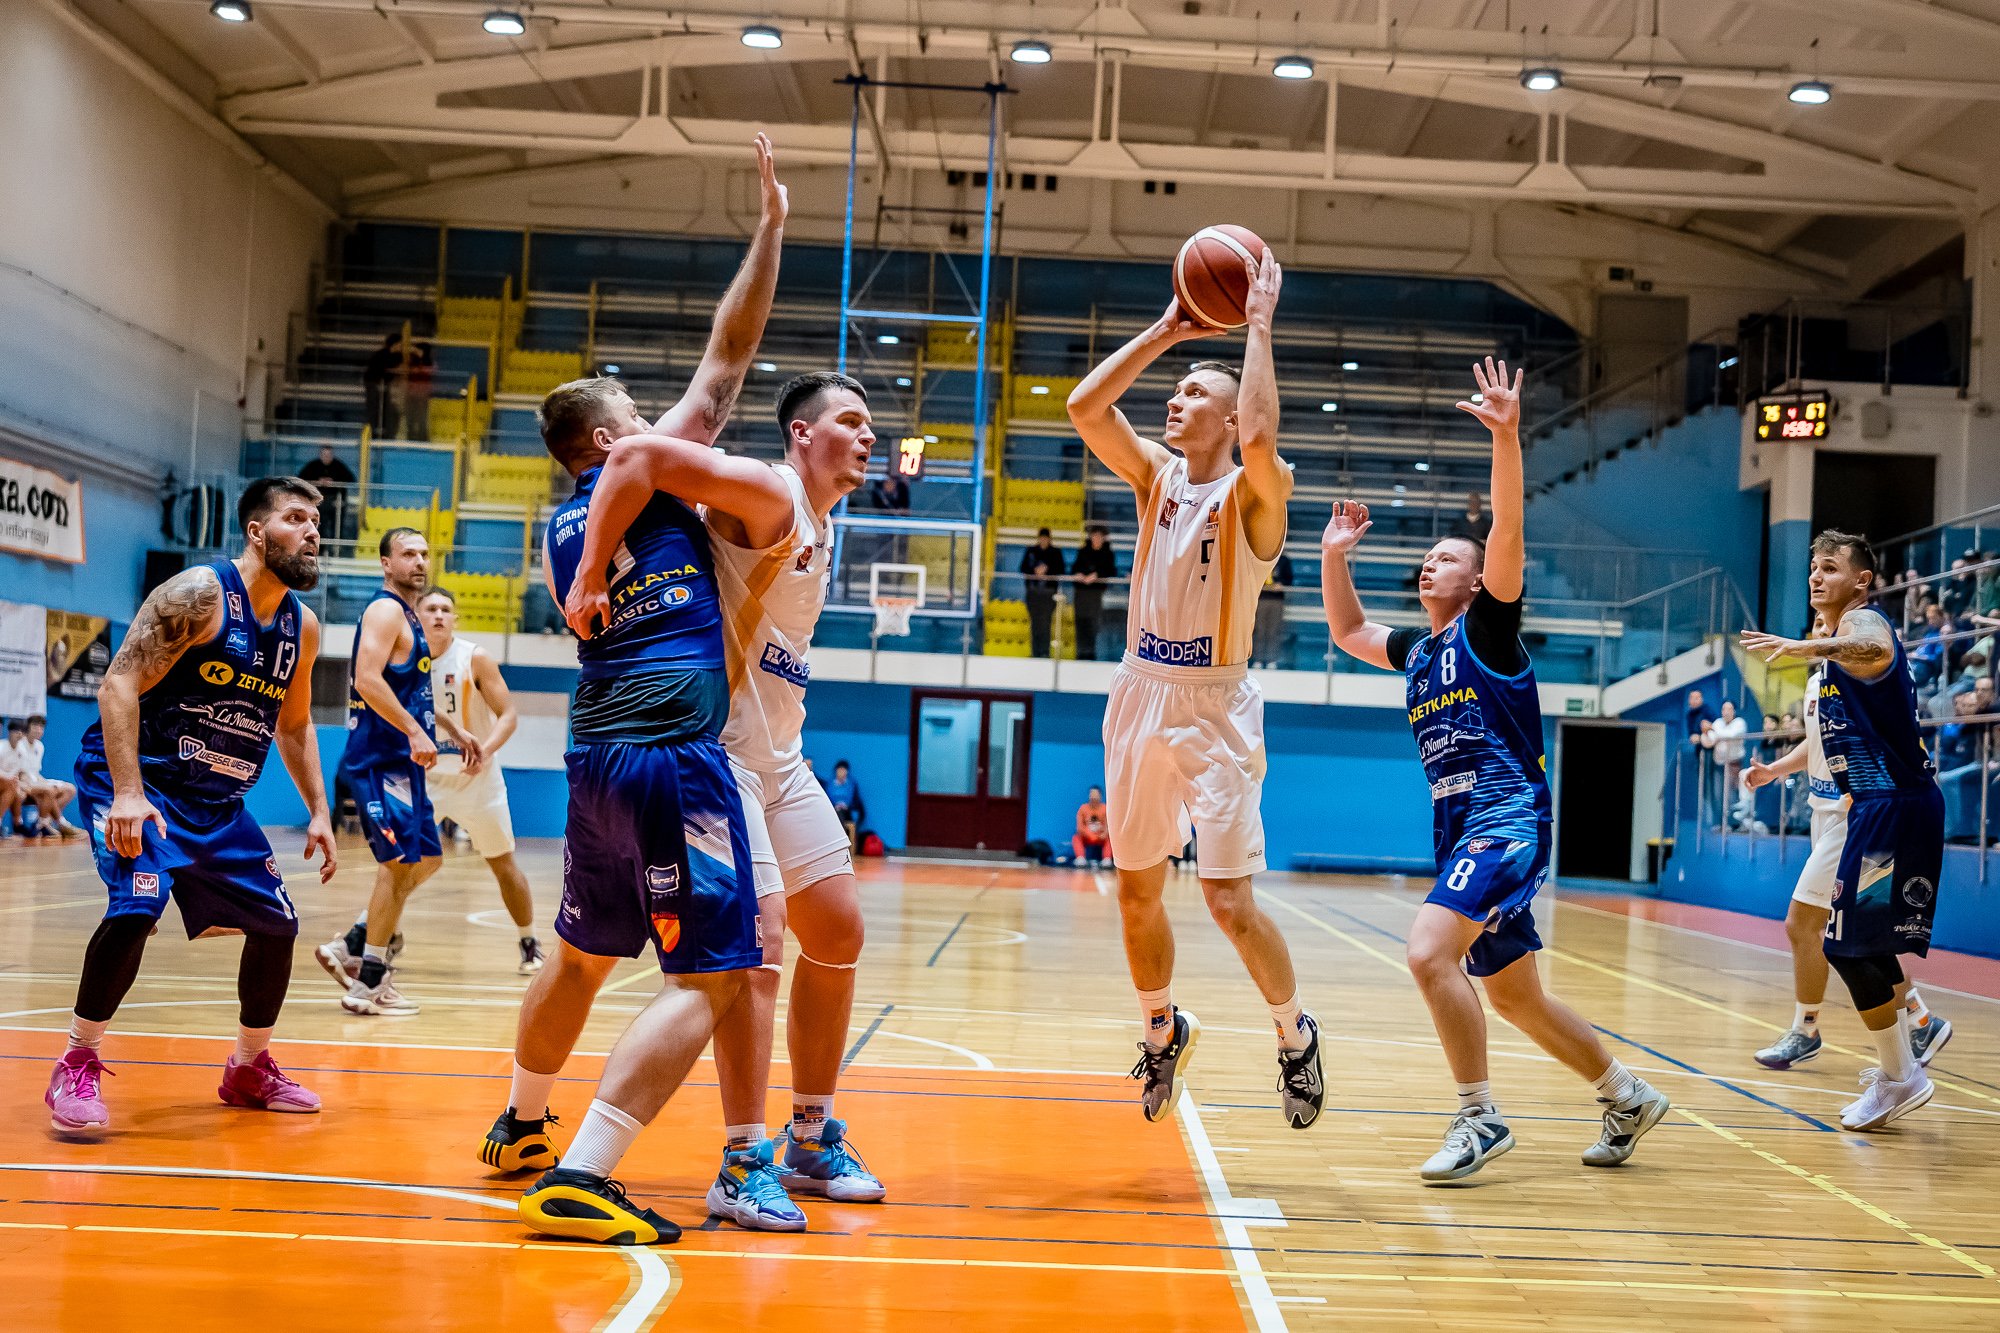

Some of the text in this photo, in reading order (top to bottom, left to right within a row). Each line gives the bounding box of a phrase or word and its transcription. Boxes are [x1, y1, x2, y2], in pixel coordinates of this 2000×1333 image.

[272, 640, 296, 681] 13
[1441, 647, 1457, 686] 8
[206, 664, 287, 701] K ZETKAMA
[445, 692, 456, 714] 3
[1410, 687, 1479, 723] ZETKAMA
[214, 708, 232, 724] La
[230, 711, 262, 734] Nonna
[1446, 858, 1477, 892] 8
[1824, 906, 1843, 941] 21
